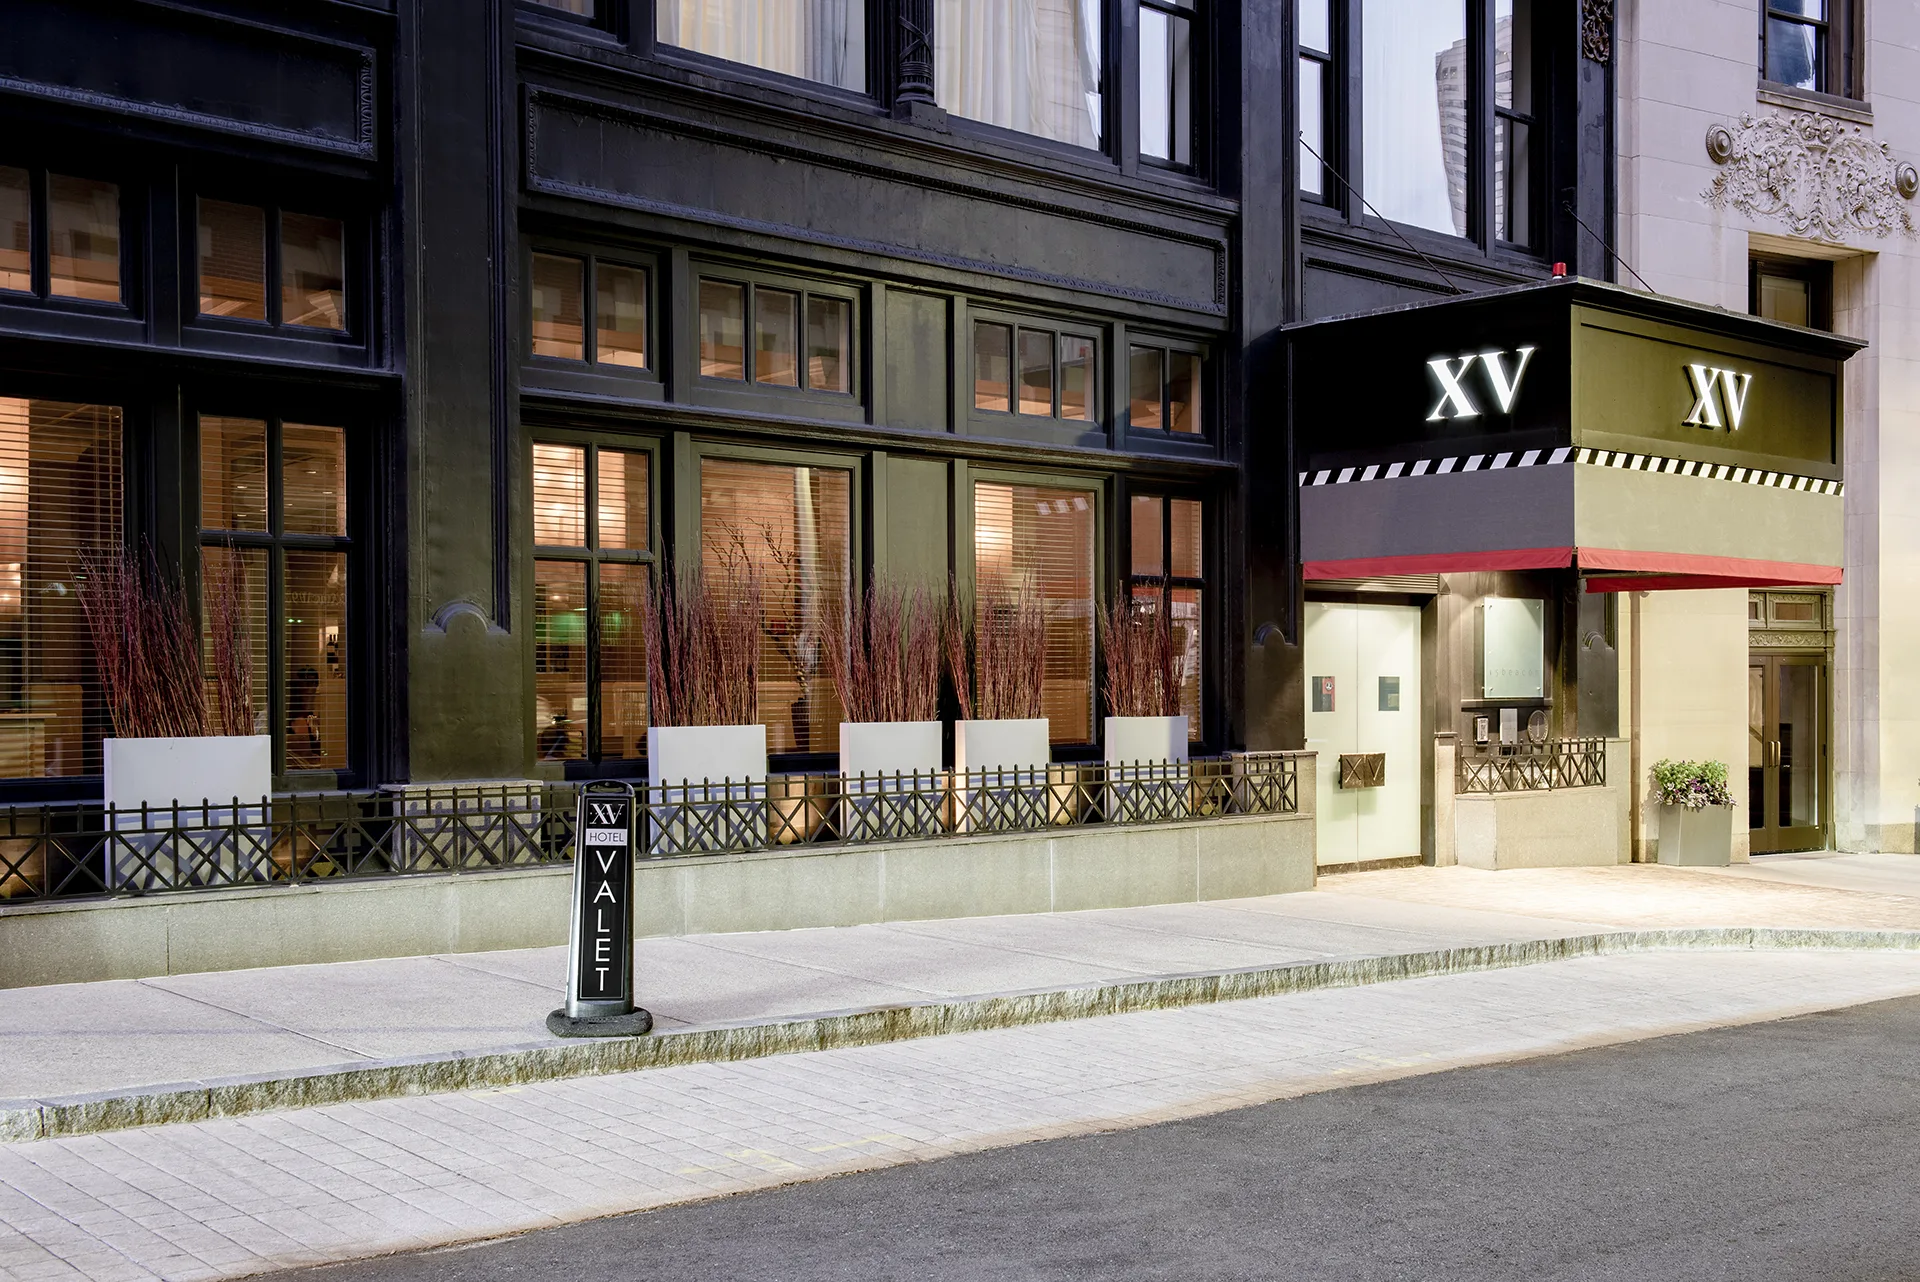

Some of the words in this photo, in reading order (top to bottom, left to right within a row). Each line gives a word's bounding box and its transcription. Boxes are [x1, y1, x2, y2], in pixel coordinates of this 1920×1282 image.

[1425, 347, 1534, 421] XV
[1684, 364, 1752, 430] XV
[589, 803, 625, 825] XV
[589, 832, 625, 842] HOTEL
[593, 851, 616, 991] VALET
